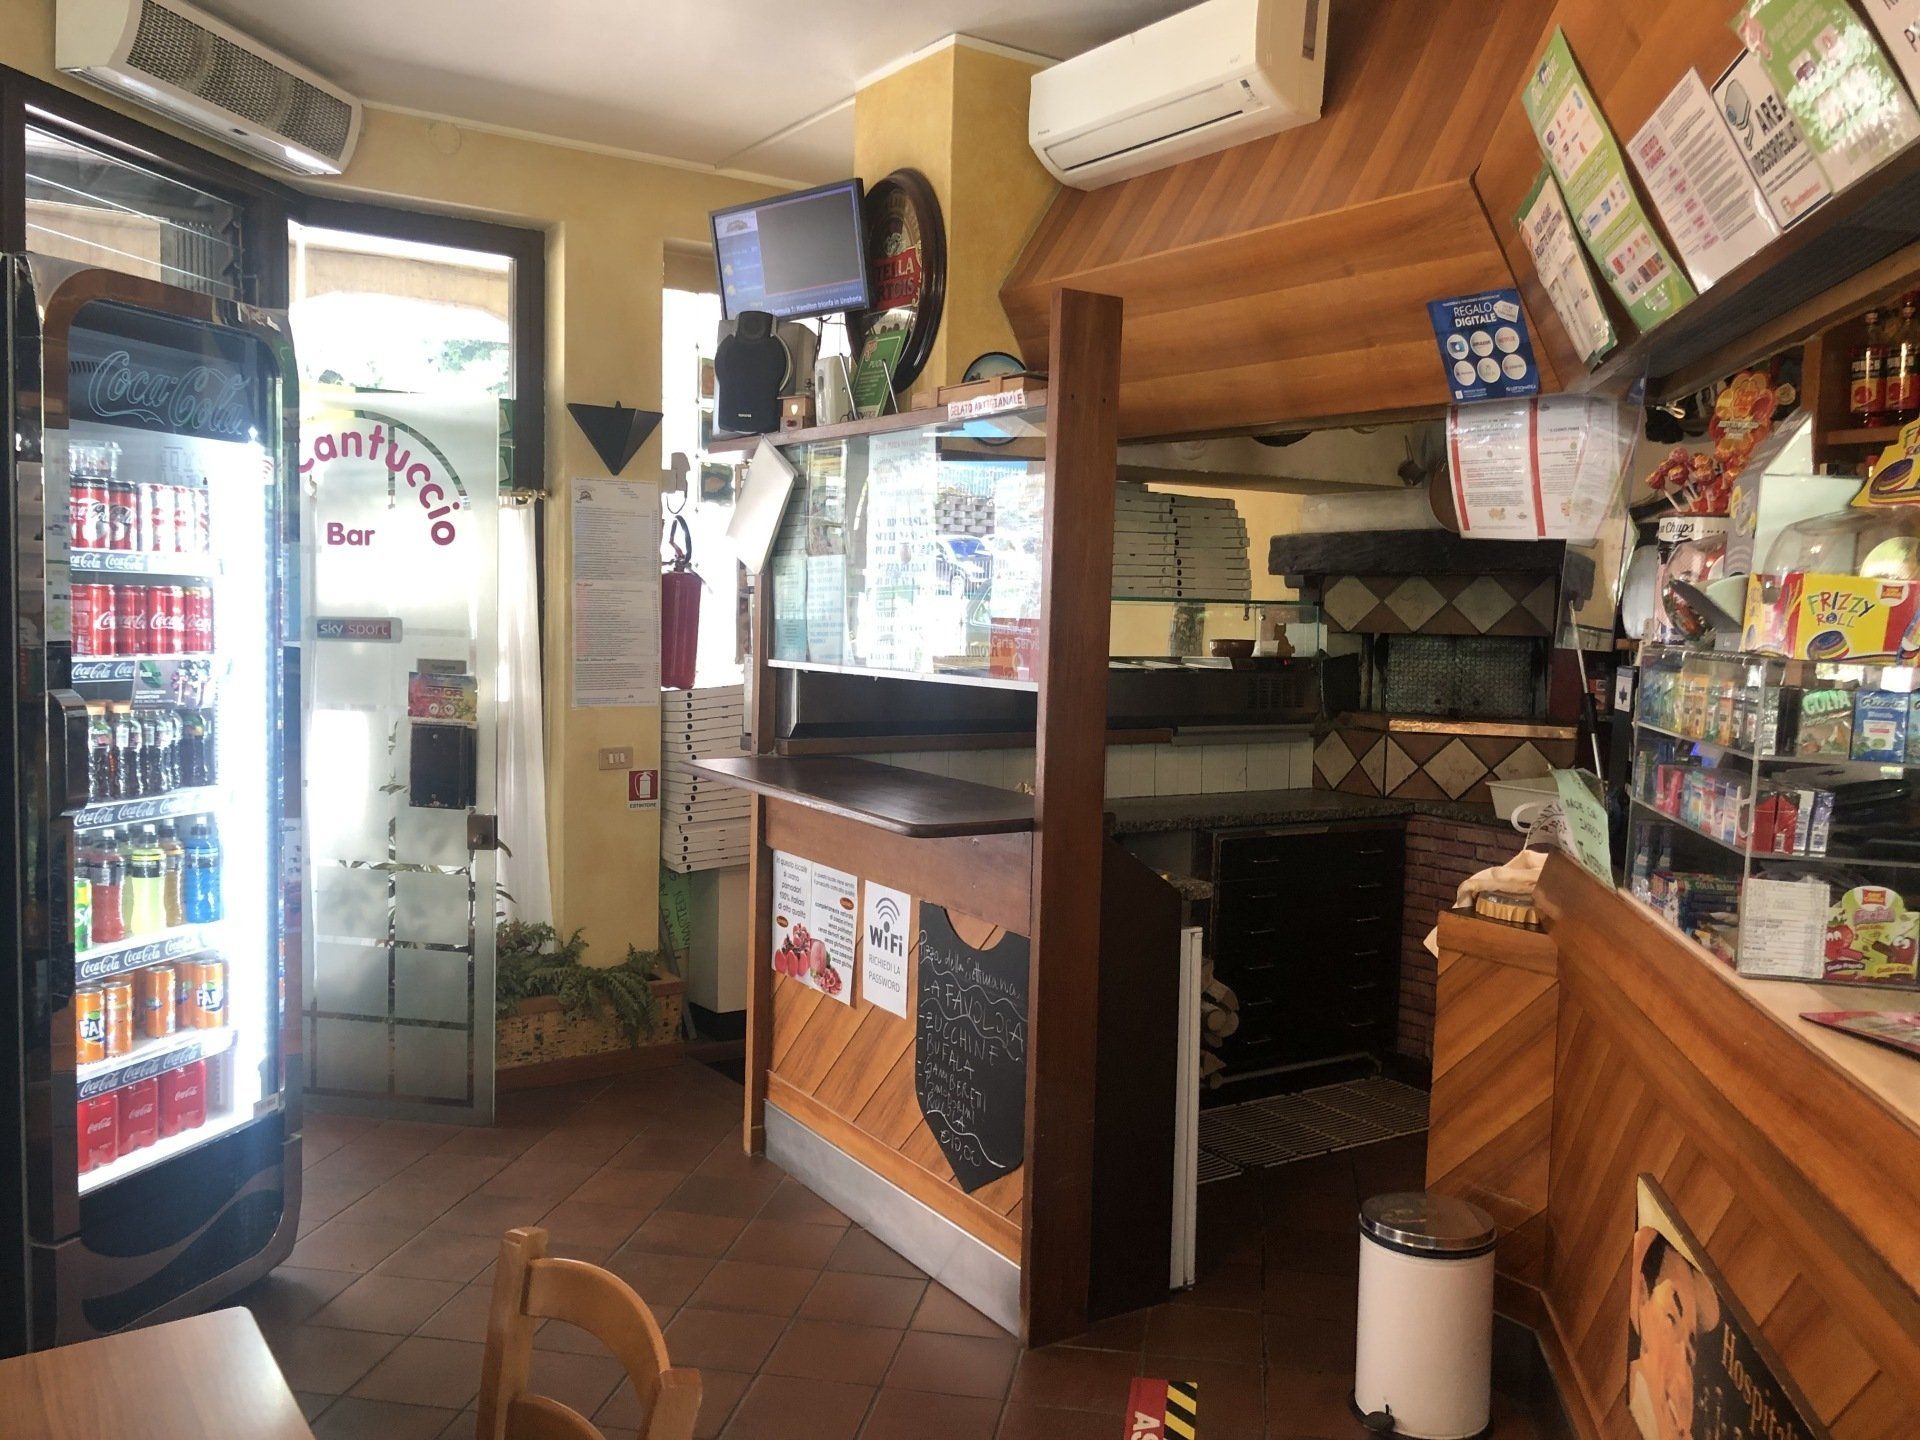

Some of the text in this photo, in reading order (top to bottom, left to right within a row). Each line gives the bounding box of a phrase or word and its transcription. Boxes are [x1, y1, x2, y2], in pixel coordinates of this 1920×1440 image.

[1454, 302, 1492, 317] REGALO
[1455, 313, 1497, 328] DIGITALE
[89, 351, 250, 435] Coca-Cola
[327, 522, 376, 546] Bar
[1806, 591, 1876, 618] FRIZZY
[320, 623, 388, 637] sky sport
[1817, 612, 1855, 629] ROLL
[1802, 690, 1851, 715] GOLIA
[869, 924, 903, 957] WiFi
[868, 953, 901, 977] RICHIEDI LA
[868, 970, 900, 993] PASSWORD
[924, 979, 940, 999] LA
[925, 1011, 999, 1066] ZUCCHINE
[926, 1032, 975, 1080] BUFALA
